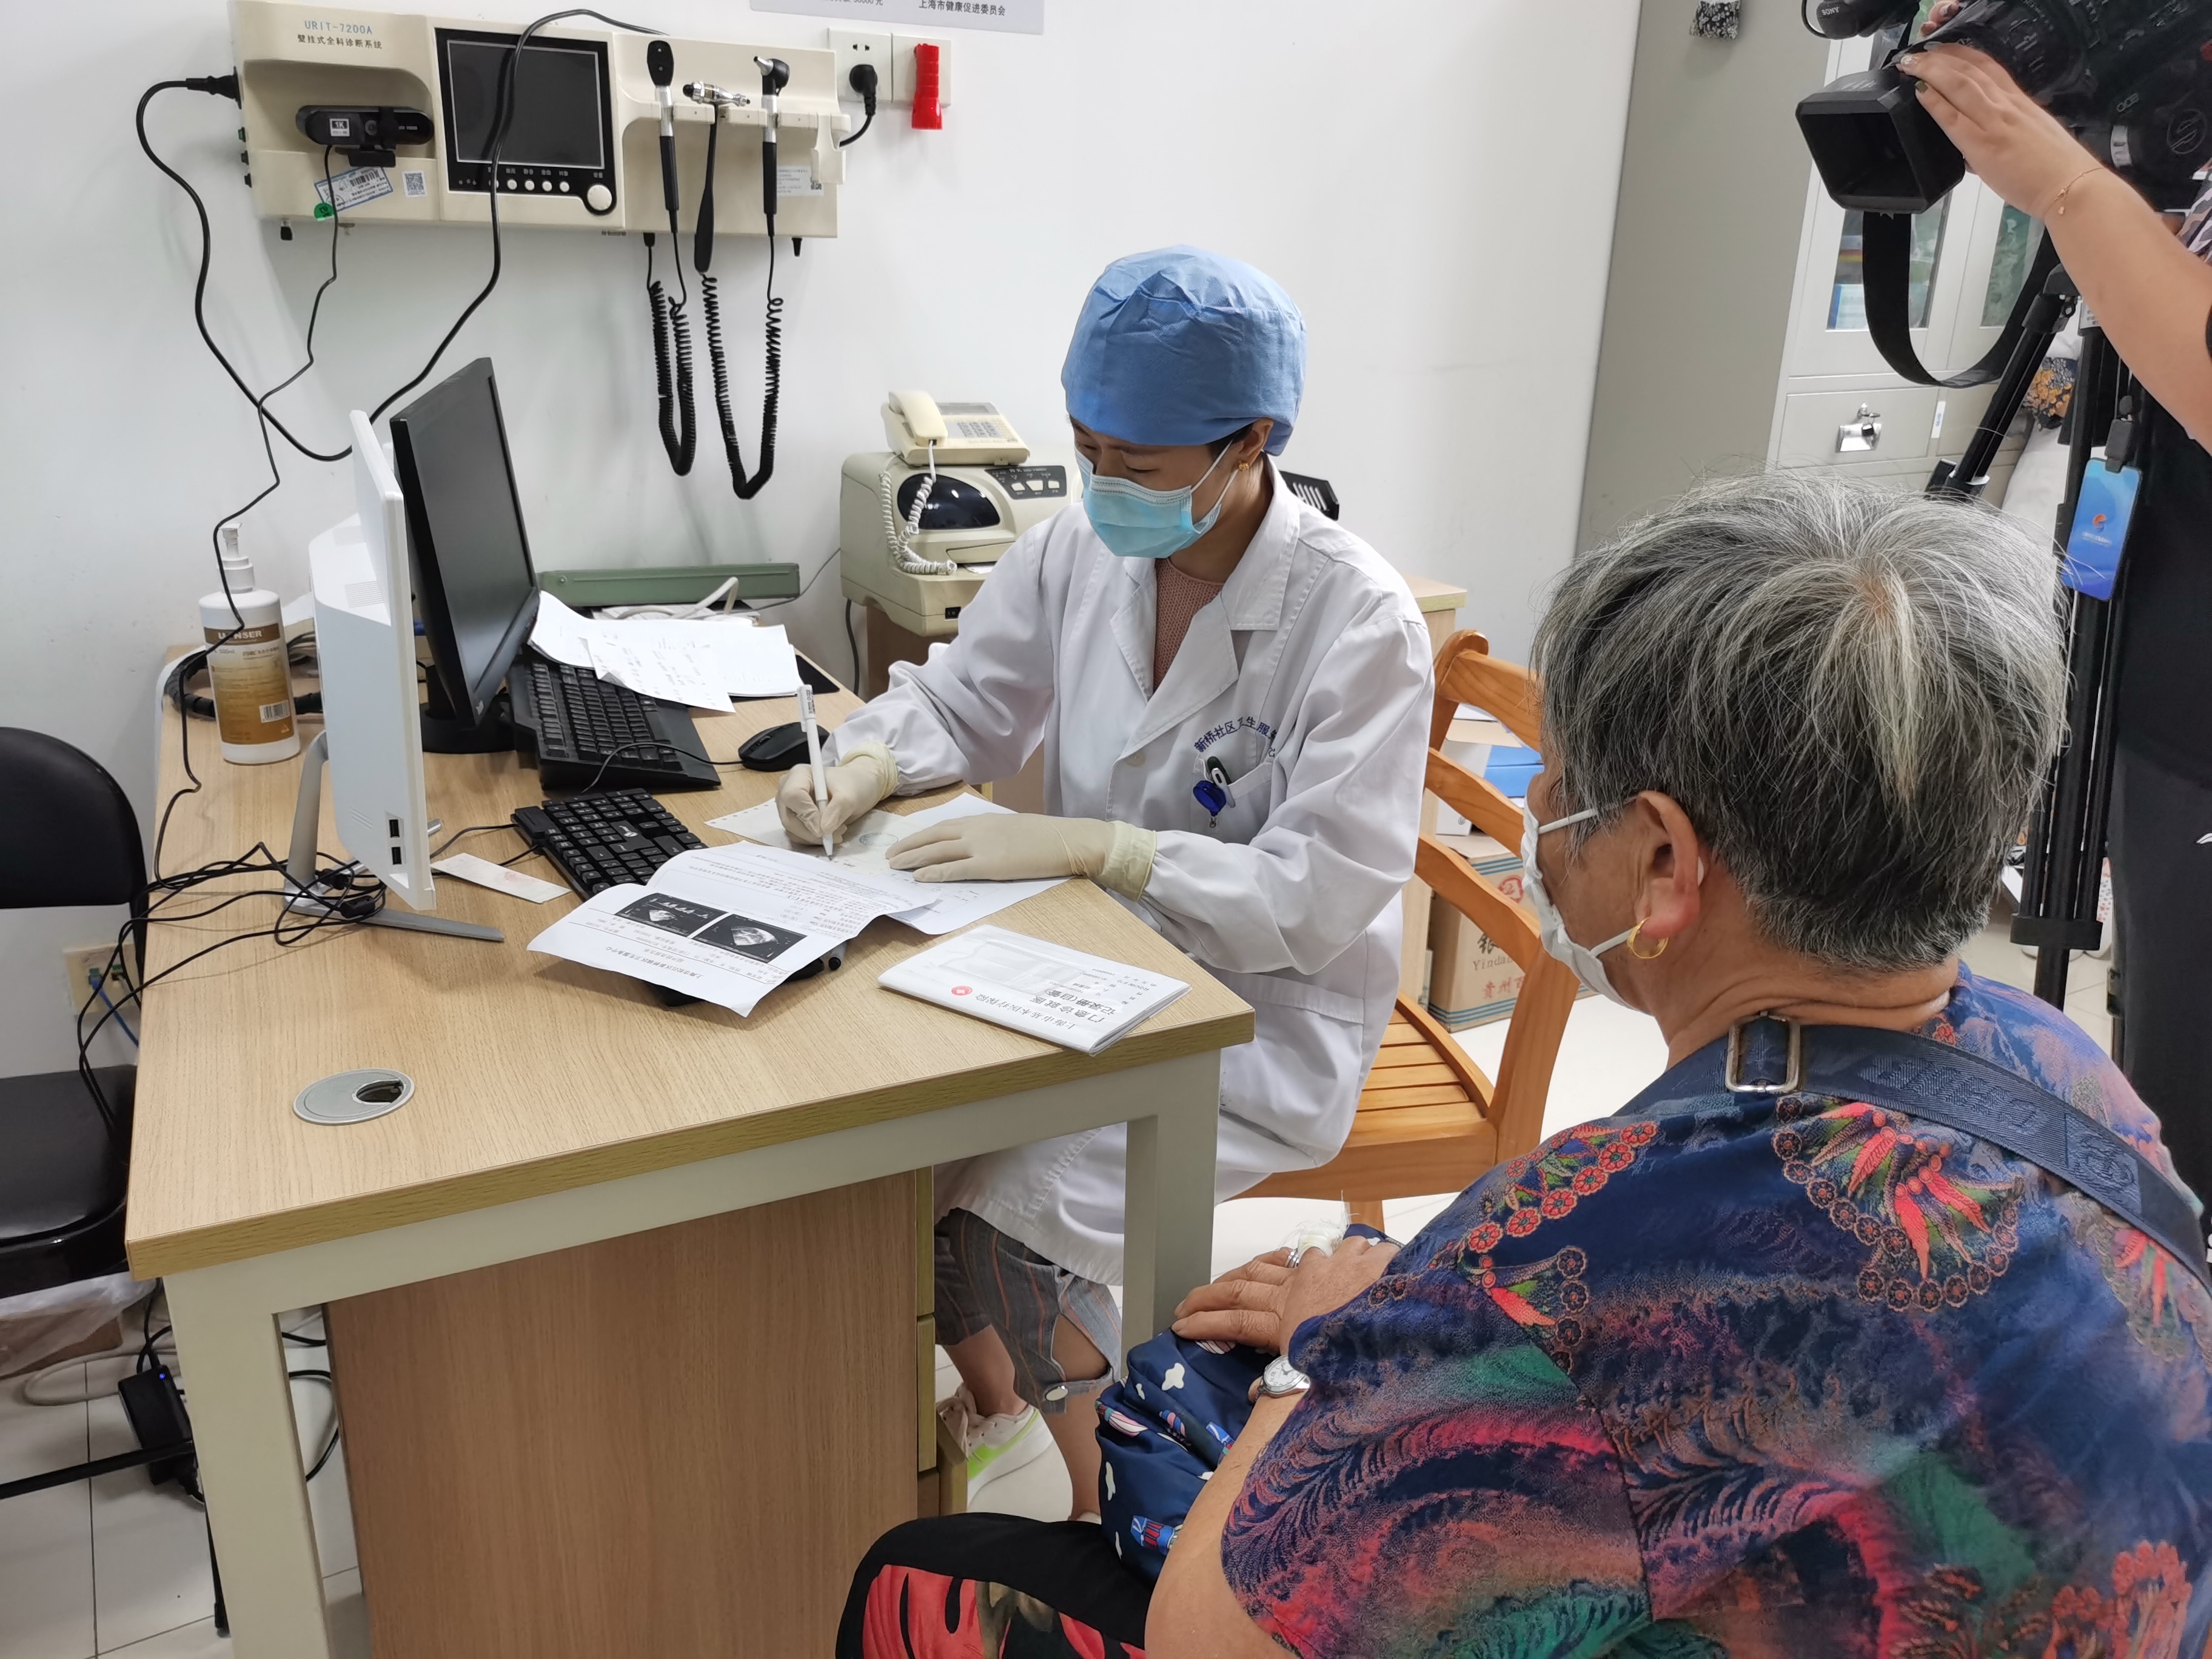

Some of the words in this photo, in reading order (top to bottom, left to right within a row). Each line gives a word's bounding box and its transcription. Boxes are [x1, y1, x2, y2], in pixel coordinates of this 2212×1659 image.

[919, 0, 1005, 16] 上海市健康促进委员会
[1822, 7, 1840, 16] SONY
[304, 20, 372, 35] URIT-7200A
[218, 630, 262, 640] UNSER
[975, 993, 1076, 1030] 上海市基本医疗保险
[1030, 996, 1105, 1023] 门急诊就医
